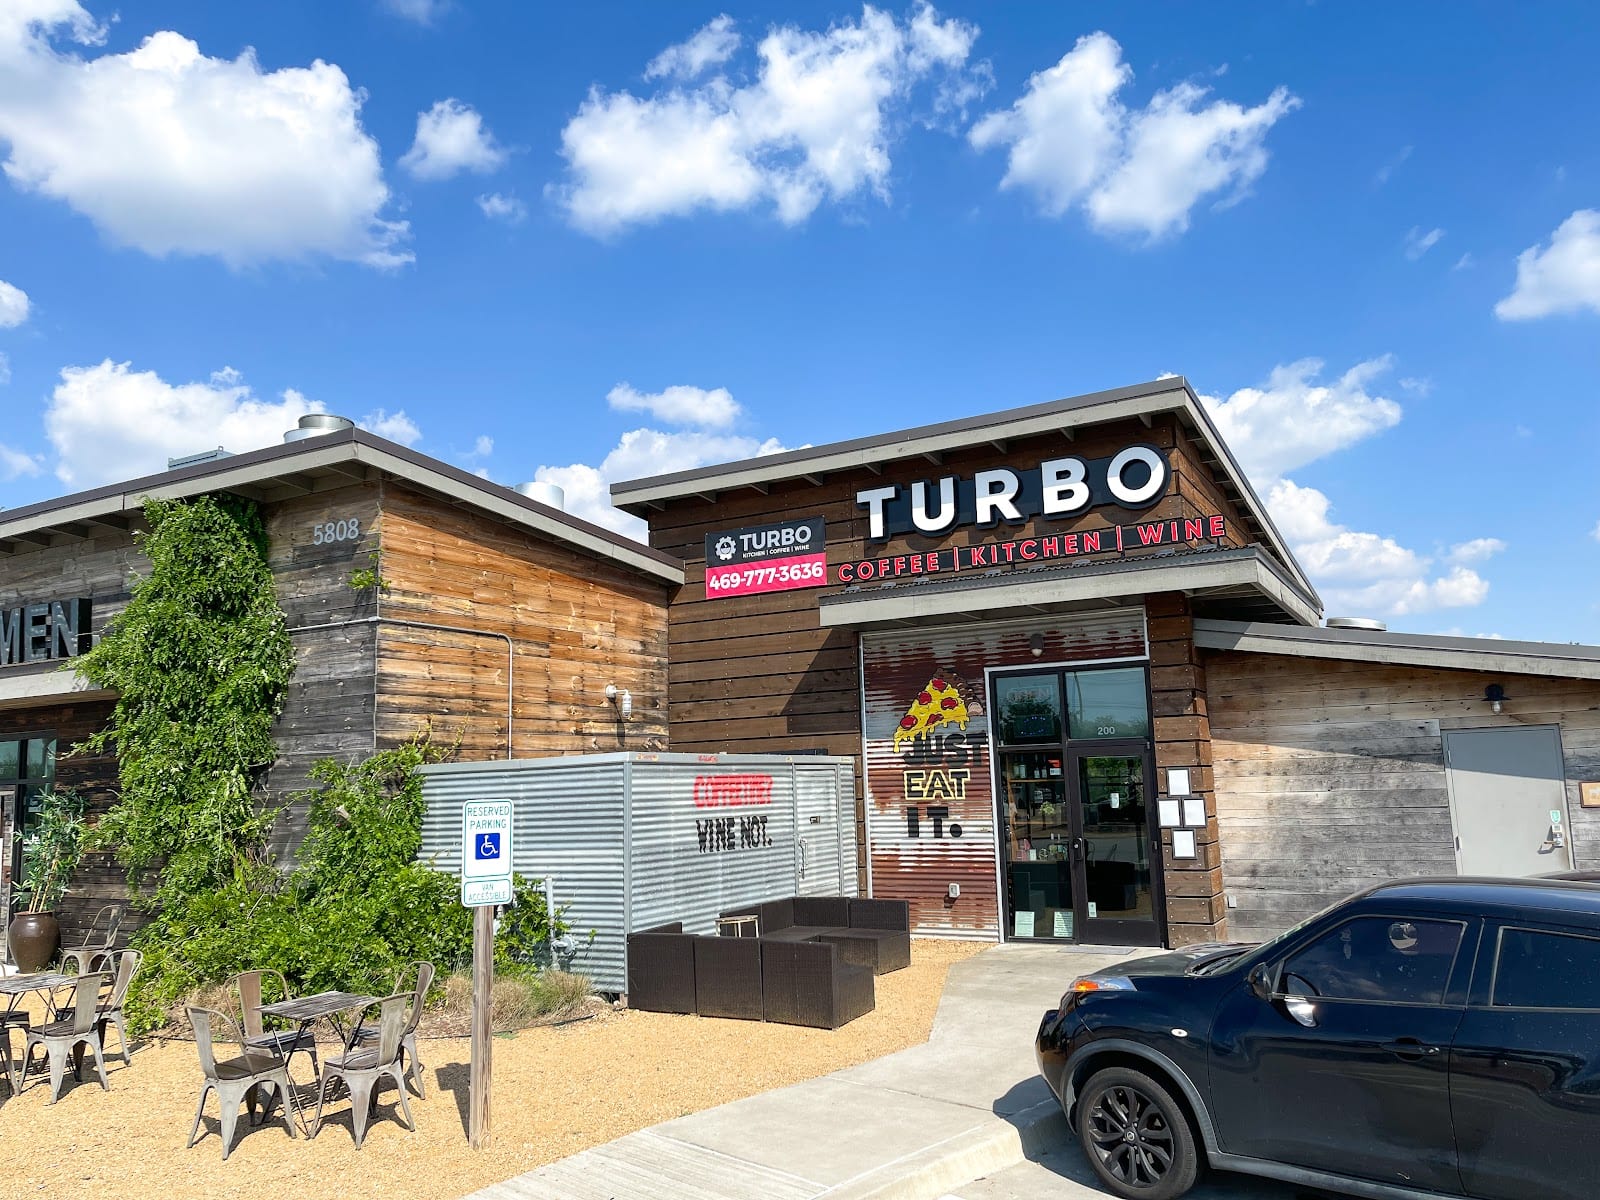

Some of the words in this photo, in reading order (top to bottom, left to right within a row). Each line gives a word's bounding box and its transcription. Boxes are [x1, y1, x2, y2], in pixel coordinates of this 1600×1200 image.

[855, 446, 1166, 539] TURBO
[313, 517, 359, 546] 5808
[739, 525, 812, 552] TURBO
[742, 551, 766, 559] KITCHEN
[769, 547, 791, 555] COFFEE
[838, 552, 940, 582] COFFEE
[970, 531, 1101, 566] KITCHEN
[1137, 515, 1226, 546] WINE
[709, 561, 824, 590] 469-777-3636
[1097, 726, 1116, 735] 200
[903, 733, 986, 767] JUST
[904, 769, 970, 800] EAT
[467, 806, 510, 817] RESERVED
[469, 819, 507, 830] PARKING
[907, 806, 963, 838] IT.
[696, 817, 735, 853] WINE
[740, 815, 773, 849] NOT.
[468, 891, 507, 901] ACCESSIBLE
